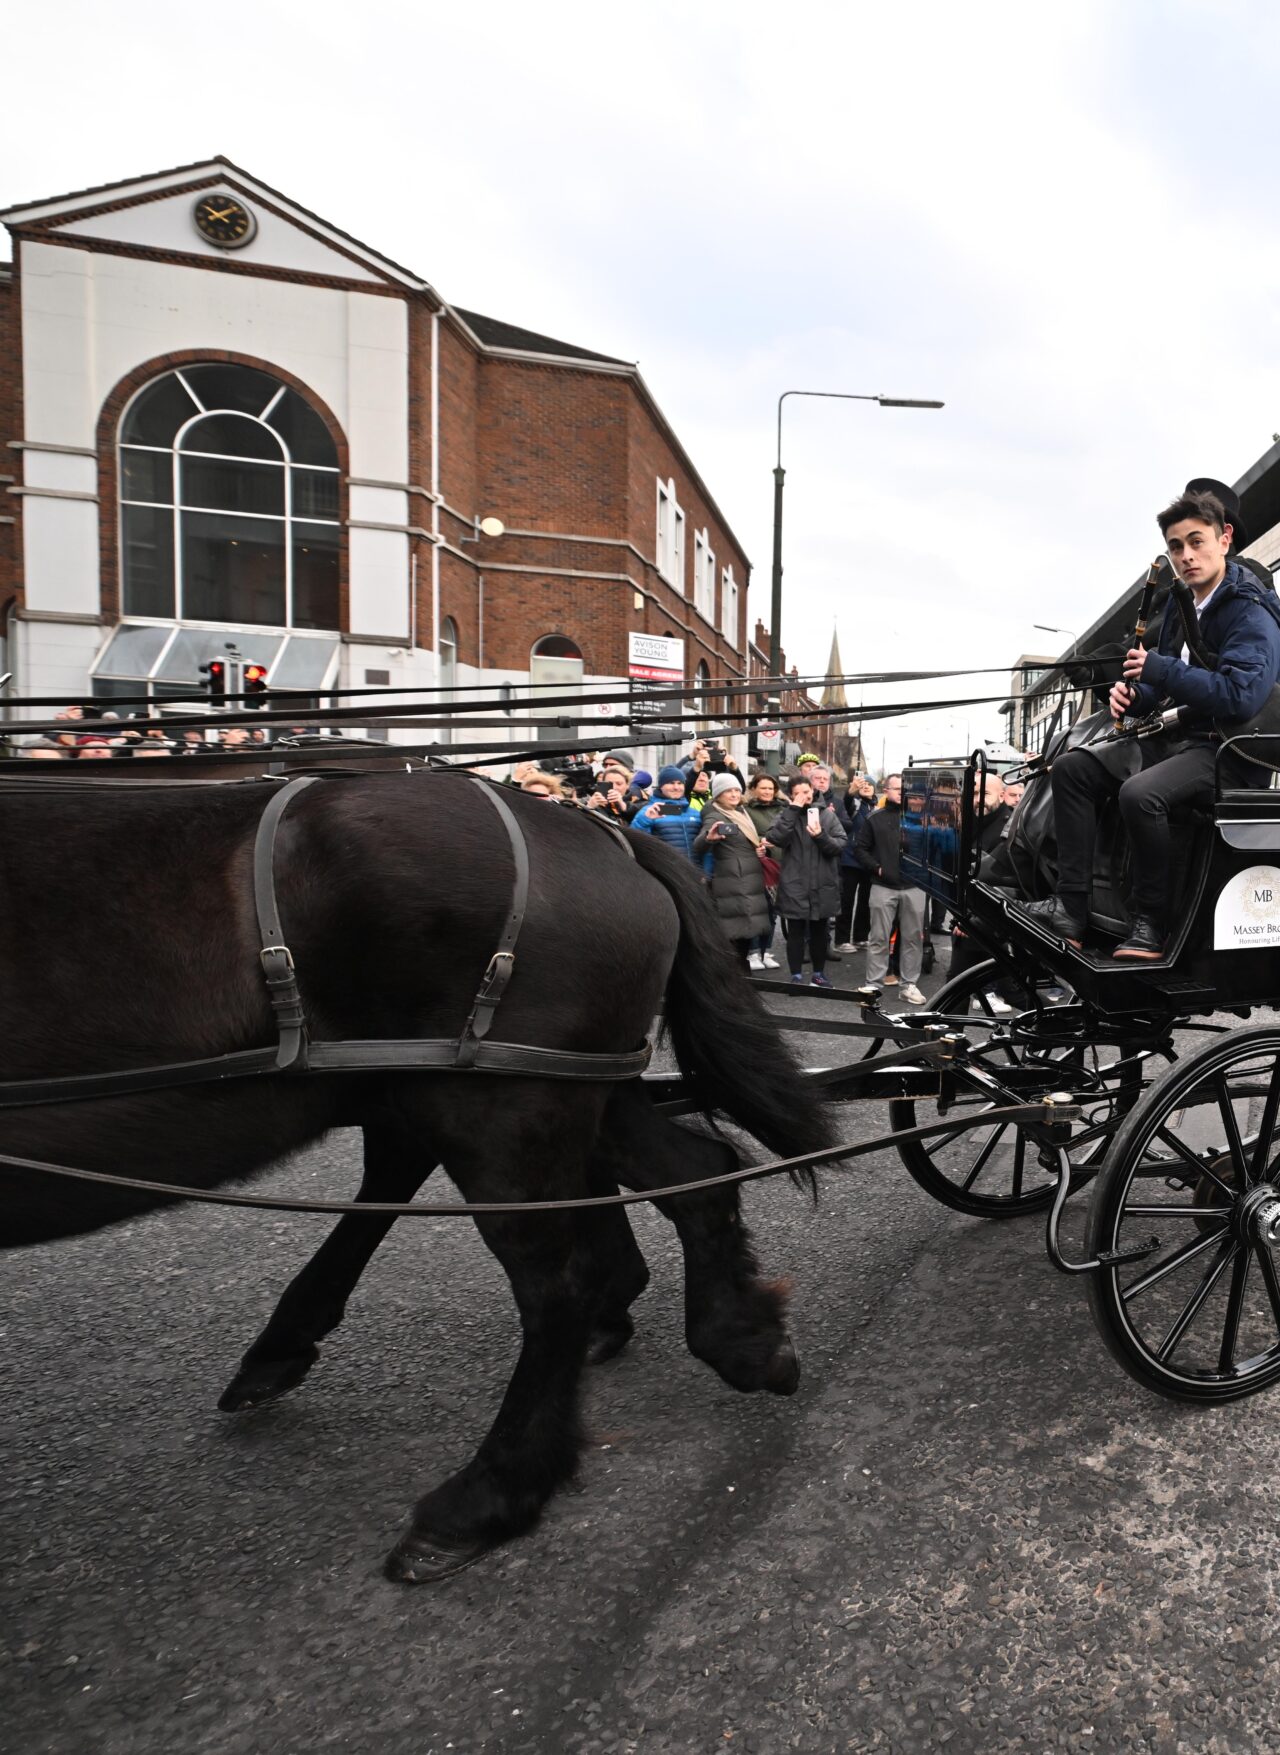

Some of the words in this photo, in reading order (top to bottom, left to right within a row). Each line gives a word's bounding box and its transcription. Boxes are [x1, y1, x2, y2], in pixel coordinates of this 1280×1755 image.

[634, 640, 667, 650] AVISON
[634, 648, 667, 657] YOUNG
[1254, 889, 1273, 903] MB
[1239, 937, 1271, 945] Honouring
